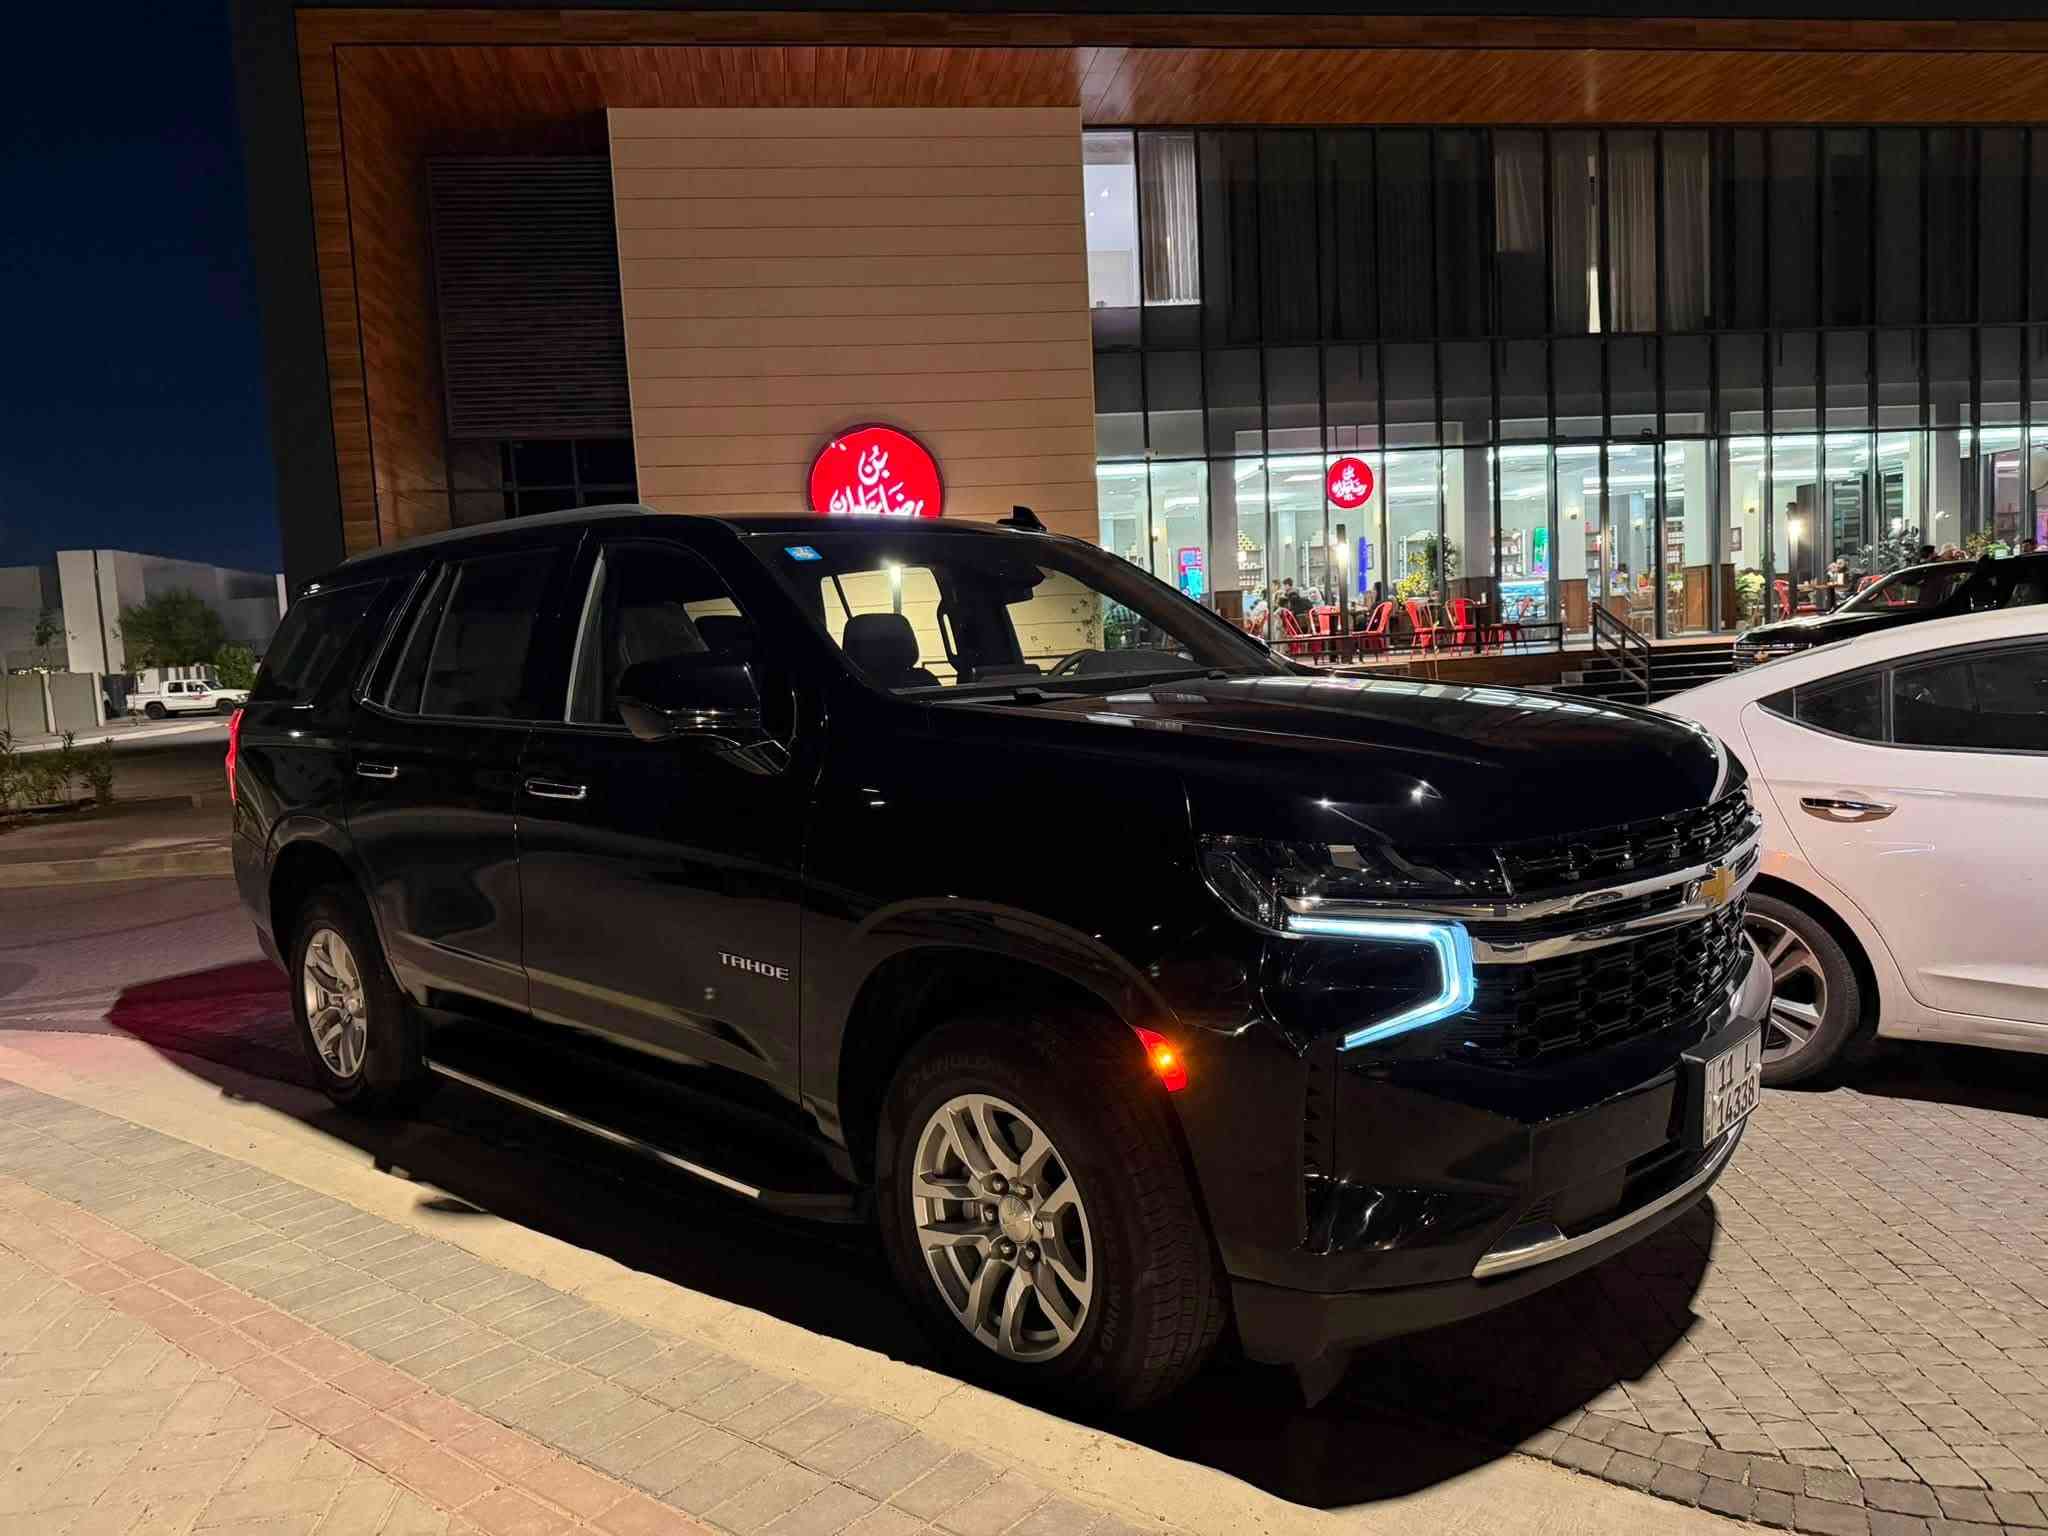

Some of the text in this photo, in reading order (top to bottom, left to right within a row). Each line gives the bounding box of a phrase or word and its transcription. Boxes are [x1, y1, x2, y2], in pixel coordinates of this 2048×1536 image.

[718, 951, 789, 981] TAHOE
[1718, 1052, 1733, 1093] 11
[1717, 1075, 1755, 1134] 14338
